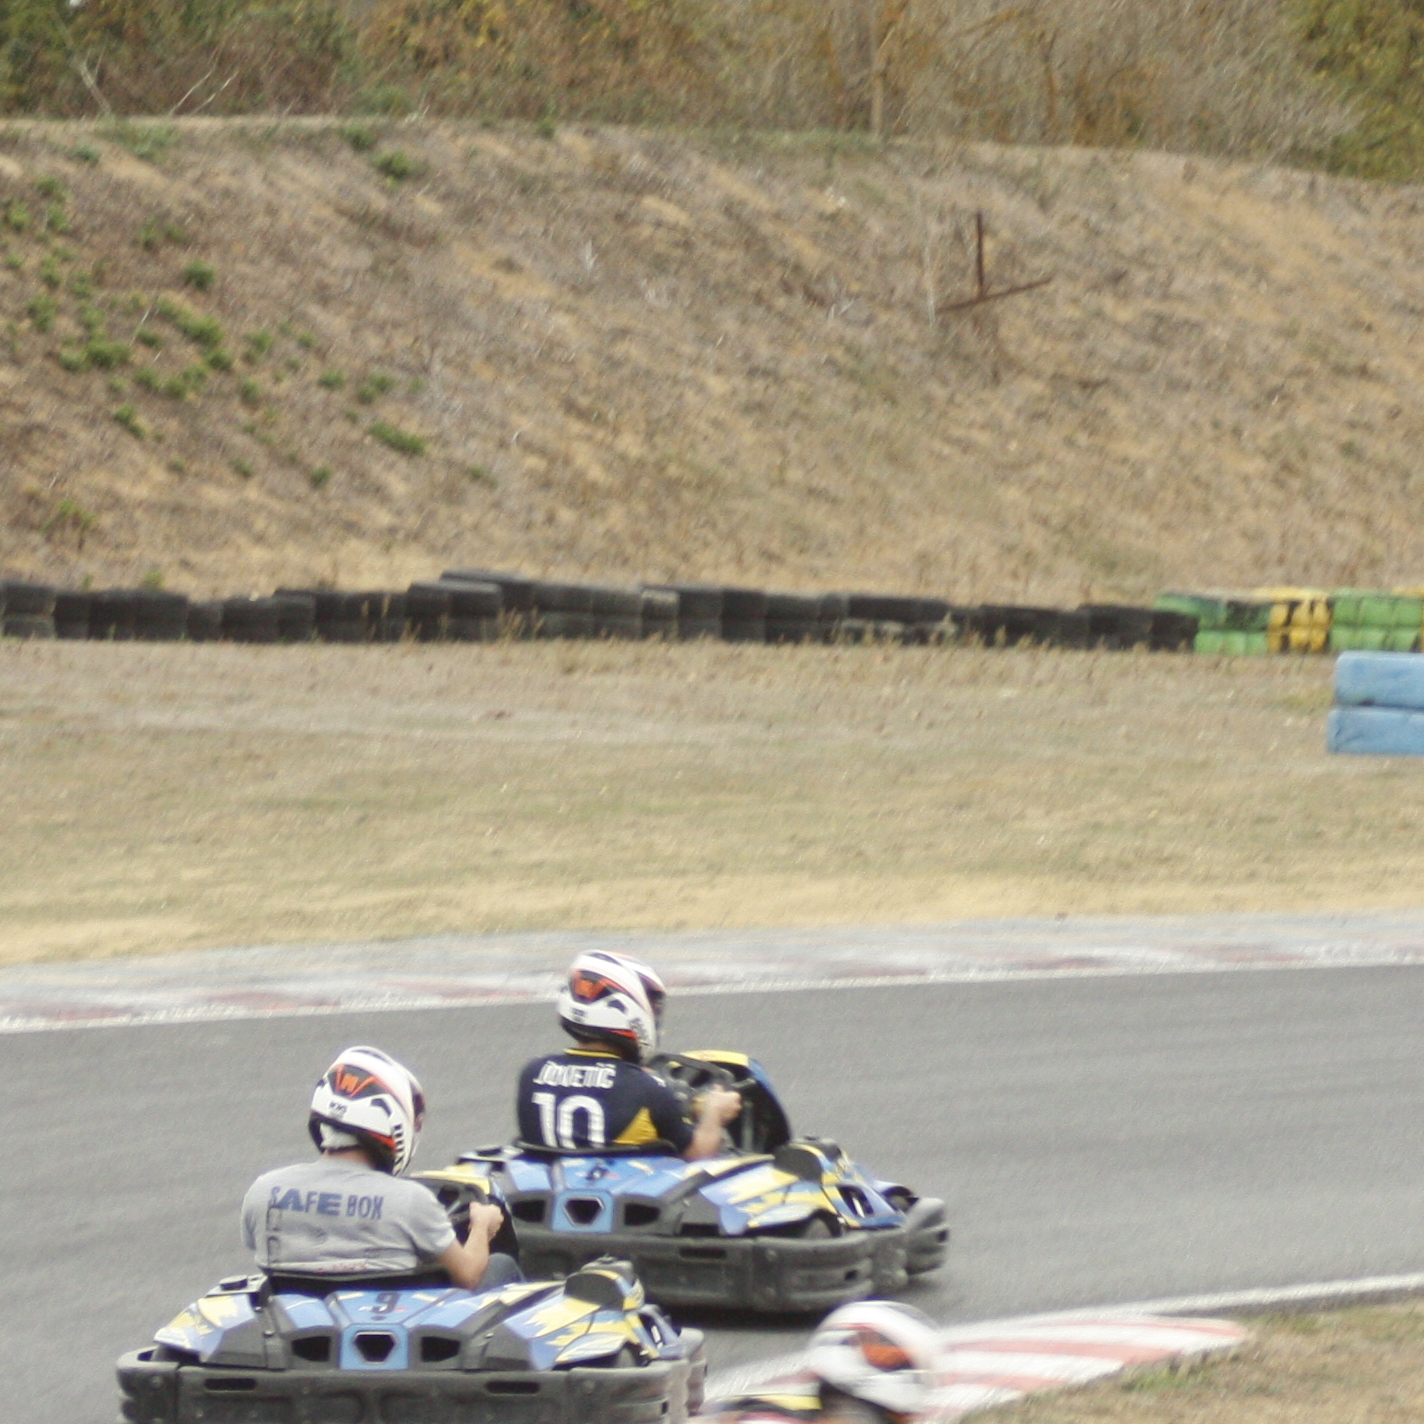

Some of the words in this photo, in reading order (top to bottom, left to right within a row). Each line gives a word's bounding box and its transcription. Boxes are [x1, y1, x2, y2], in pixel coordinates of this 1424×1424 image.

[531, 1091, 605, 1149] 10
[269, 1186, 343, 1216] SAFE
[345, 1194, 385, 1220] BOX
